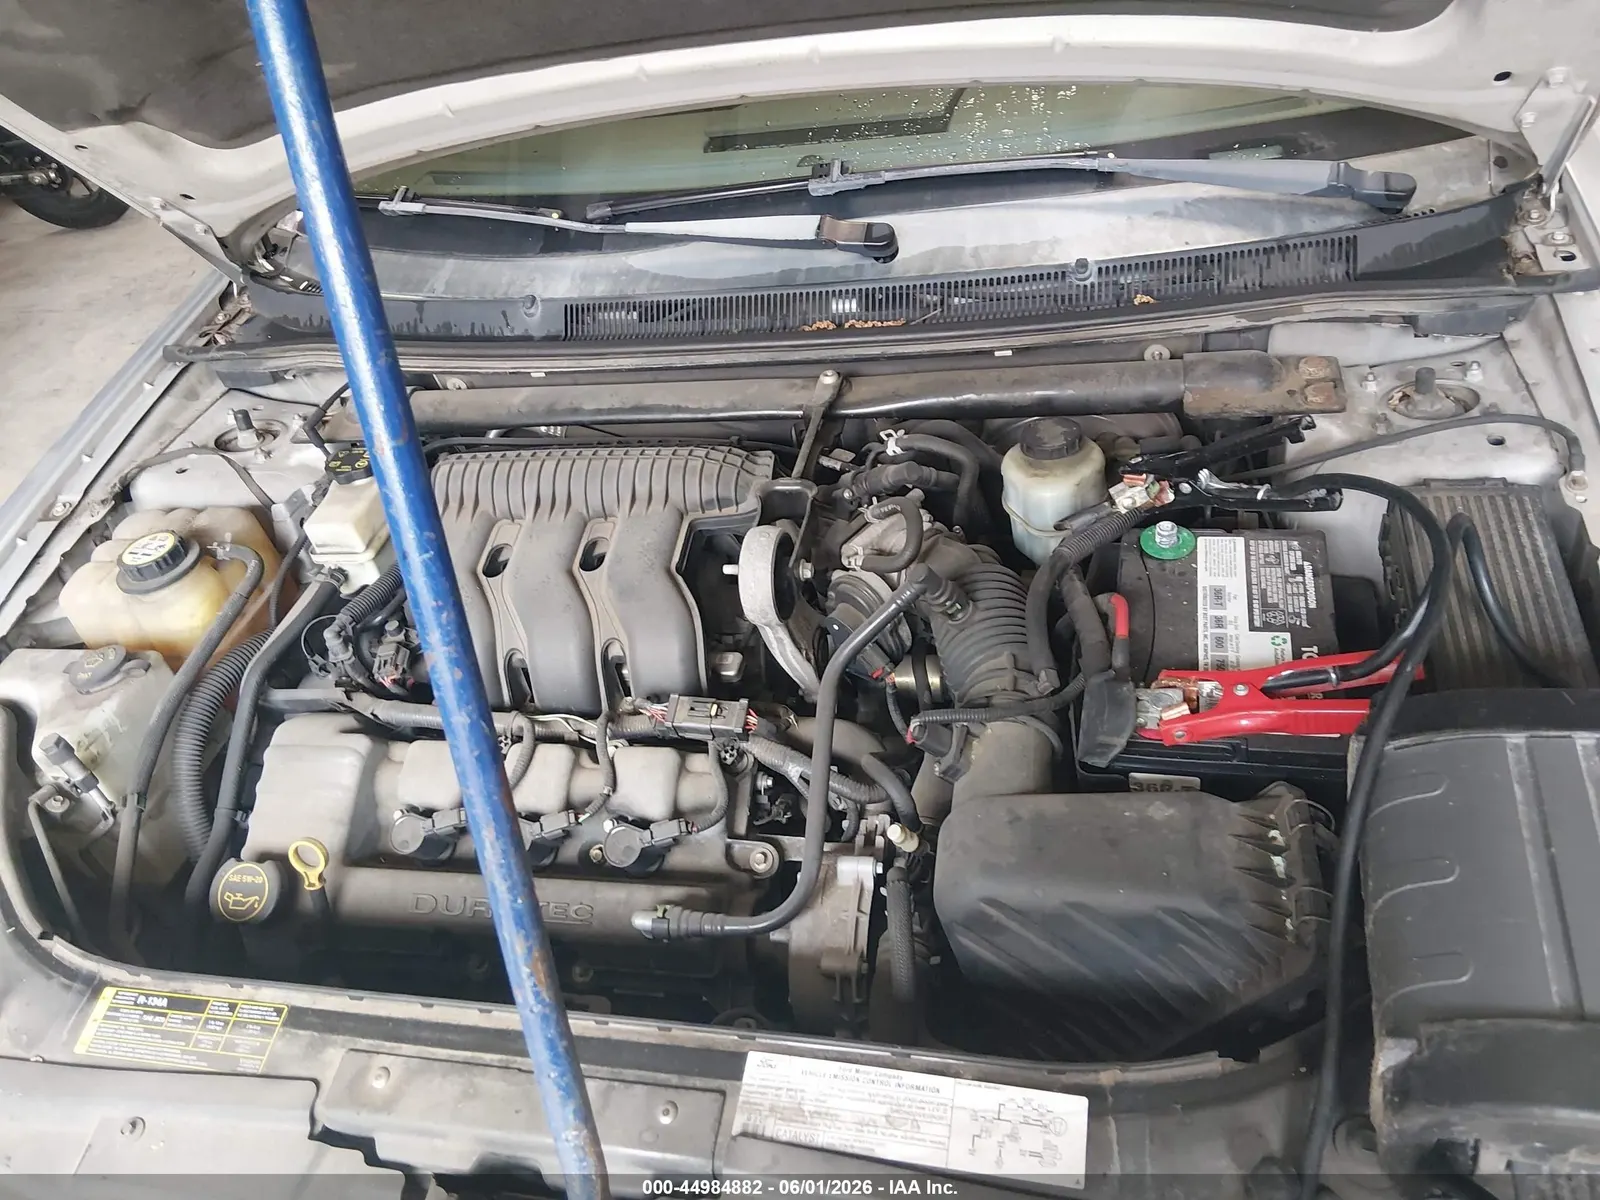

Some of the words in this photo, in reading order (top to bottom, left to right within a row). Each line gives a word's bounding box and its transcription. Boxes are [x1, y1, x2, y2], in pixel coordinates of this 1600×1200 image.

[1214, 615, 1224, 628] 36R
[1215, 636, 1225, 649] 600
[228, 874, 242, 883] SAE
[242, 875, 263, 884] 5W-20
[410, 892, 595, 921] DUREC
